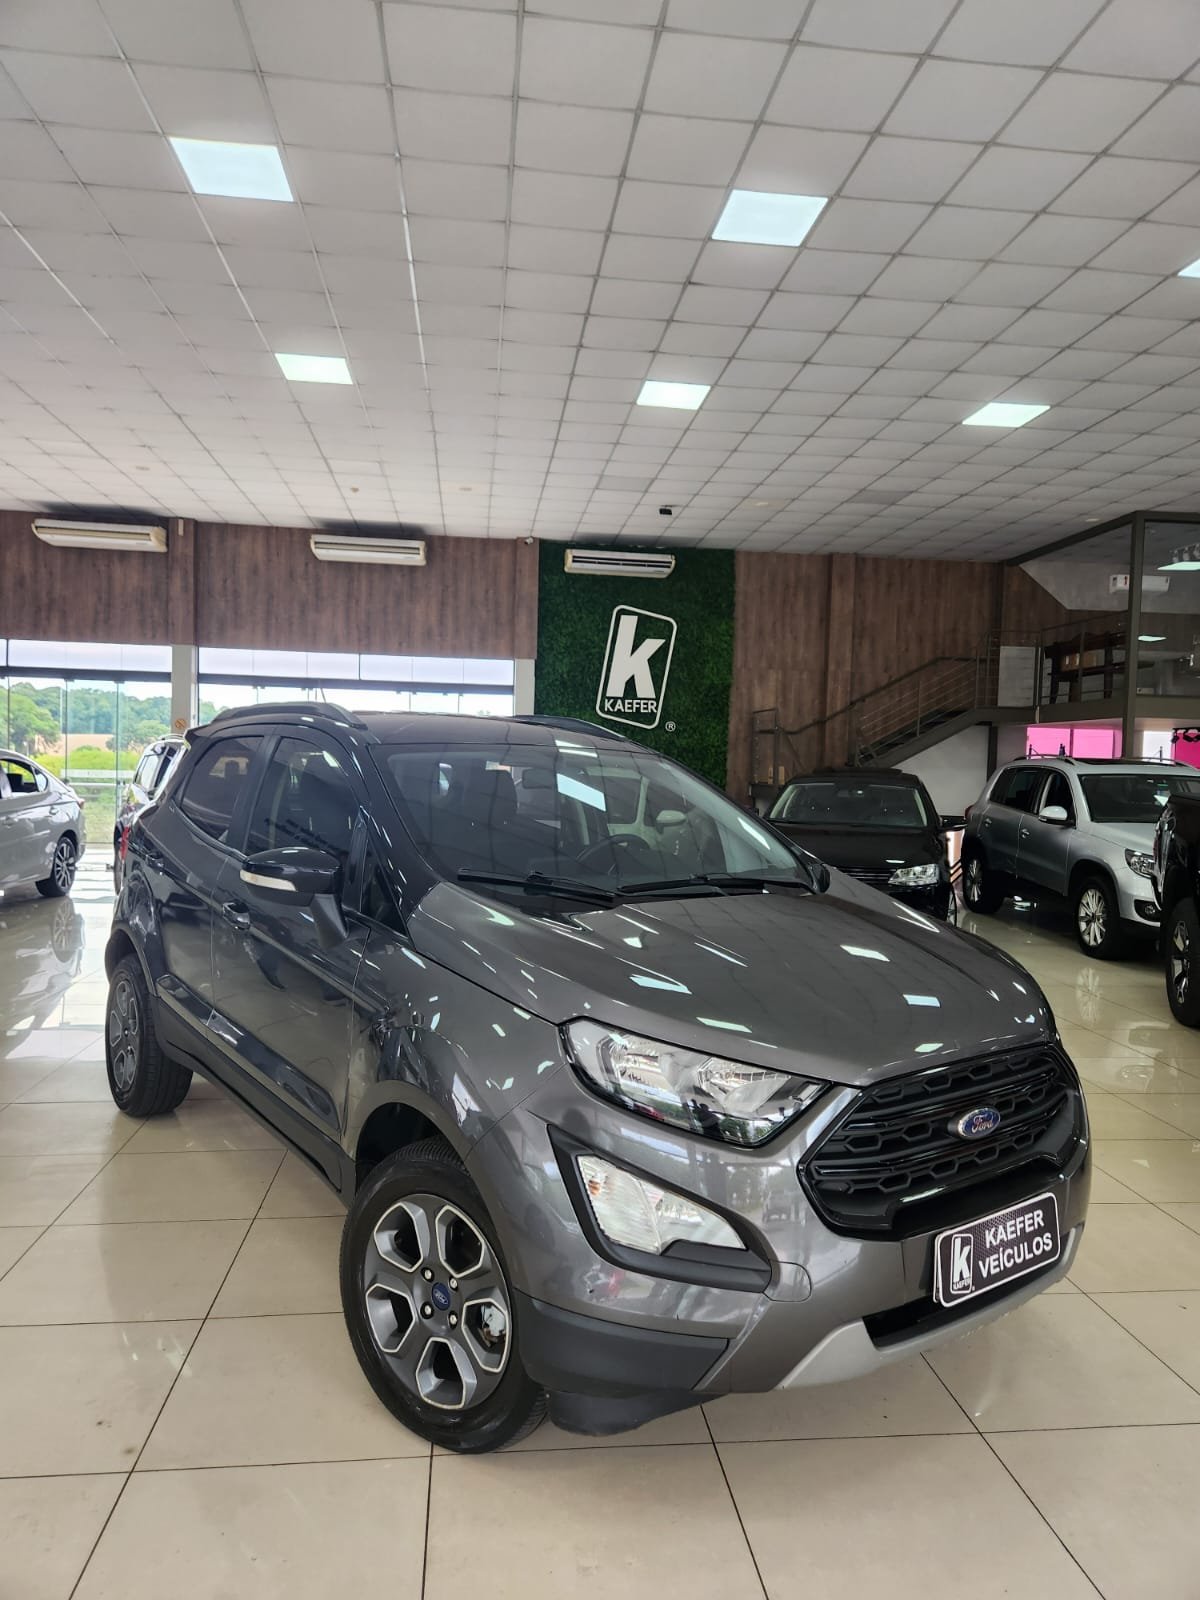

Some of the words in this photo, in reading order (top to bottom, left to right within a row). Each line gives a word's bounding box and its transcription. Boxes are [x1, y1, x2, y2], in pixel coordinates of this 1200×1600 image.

[604, 699, 657, 713] KAEFER
[985, 1209, 1045, 1249] KAEFER
[979, 1232, 1053, 1278] VEÍCULOS
